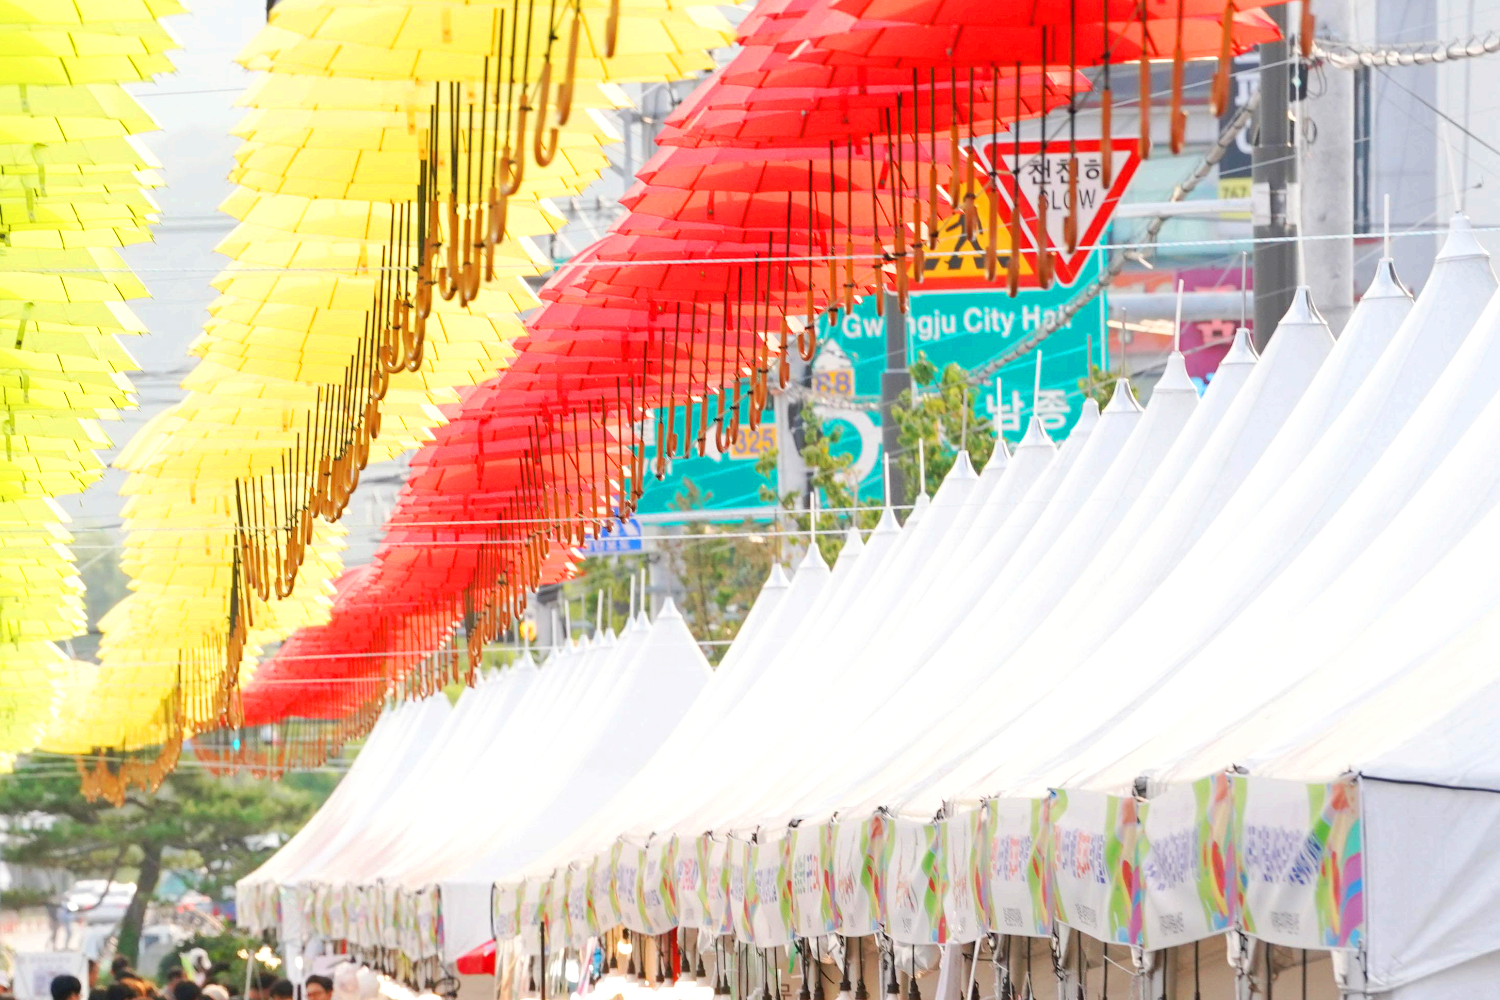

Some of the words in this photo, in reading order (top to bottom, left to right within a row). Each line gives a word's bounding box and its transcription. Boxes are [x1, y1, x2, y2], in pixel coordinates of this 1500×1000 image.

[842, 308, 956, 341] Gwngju
[964, 307, 1015, 338] City
[986, 389, 1071, 431] 남종
[734, 428, 774, 454] 325
